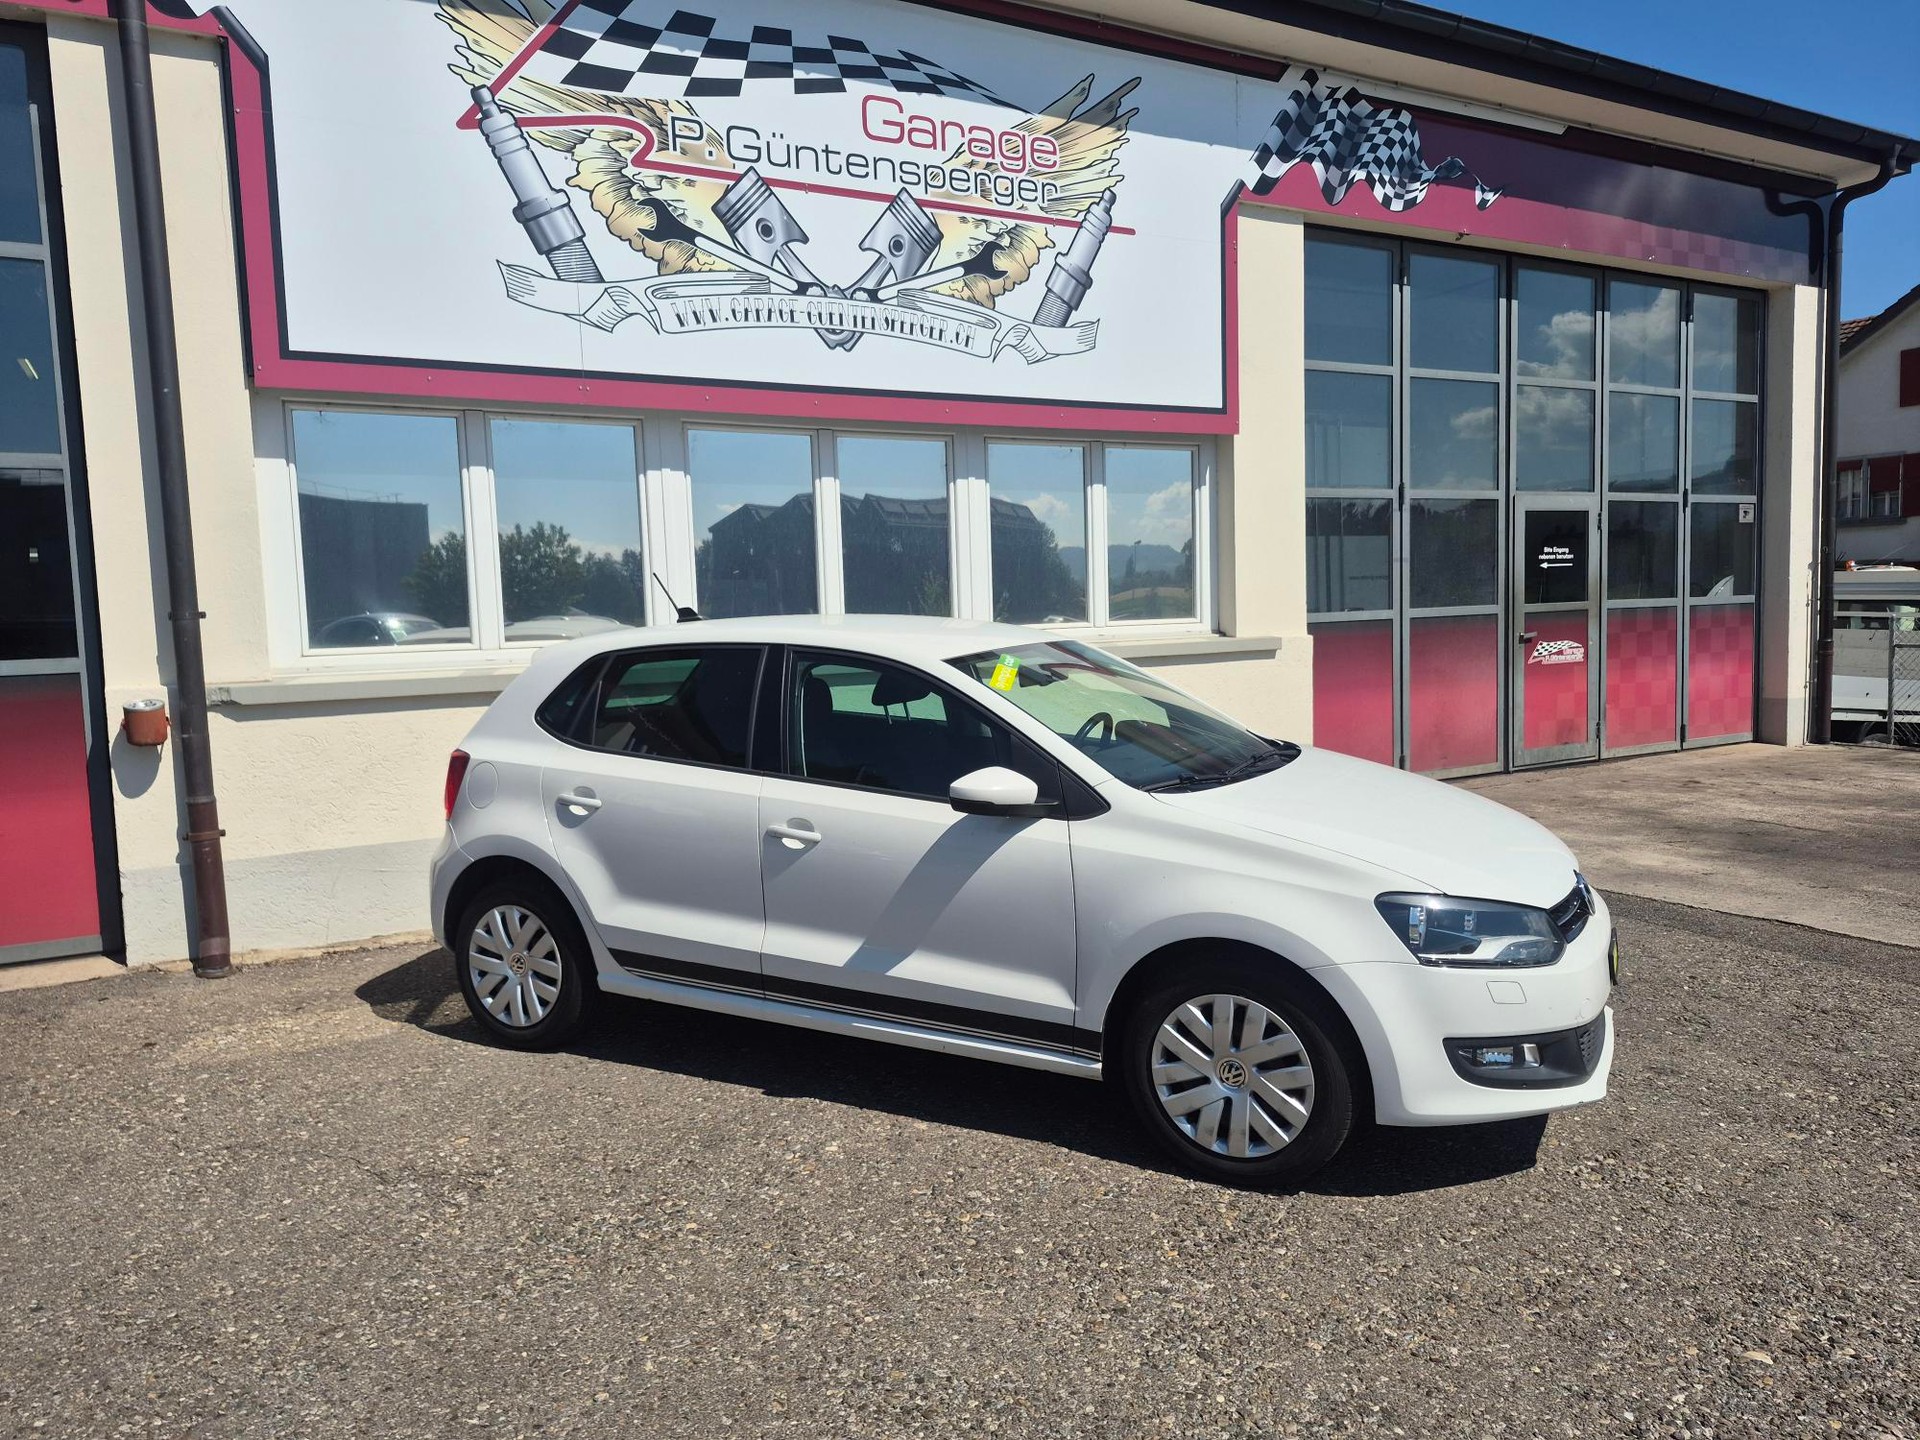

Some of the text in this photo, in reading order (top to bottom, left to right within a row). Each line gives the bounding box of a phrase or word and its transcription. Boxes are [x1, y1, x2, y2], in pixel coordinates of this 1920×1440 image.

[671, 116, 1058, 207] P. Güntensperger
[862, 94, 1058, 174] Garage
[670, 297, 977, 350] WWW.GARAGE-GUENTENSPERGER.CH
